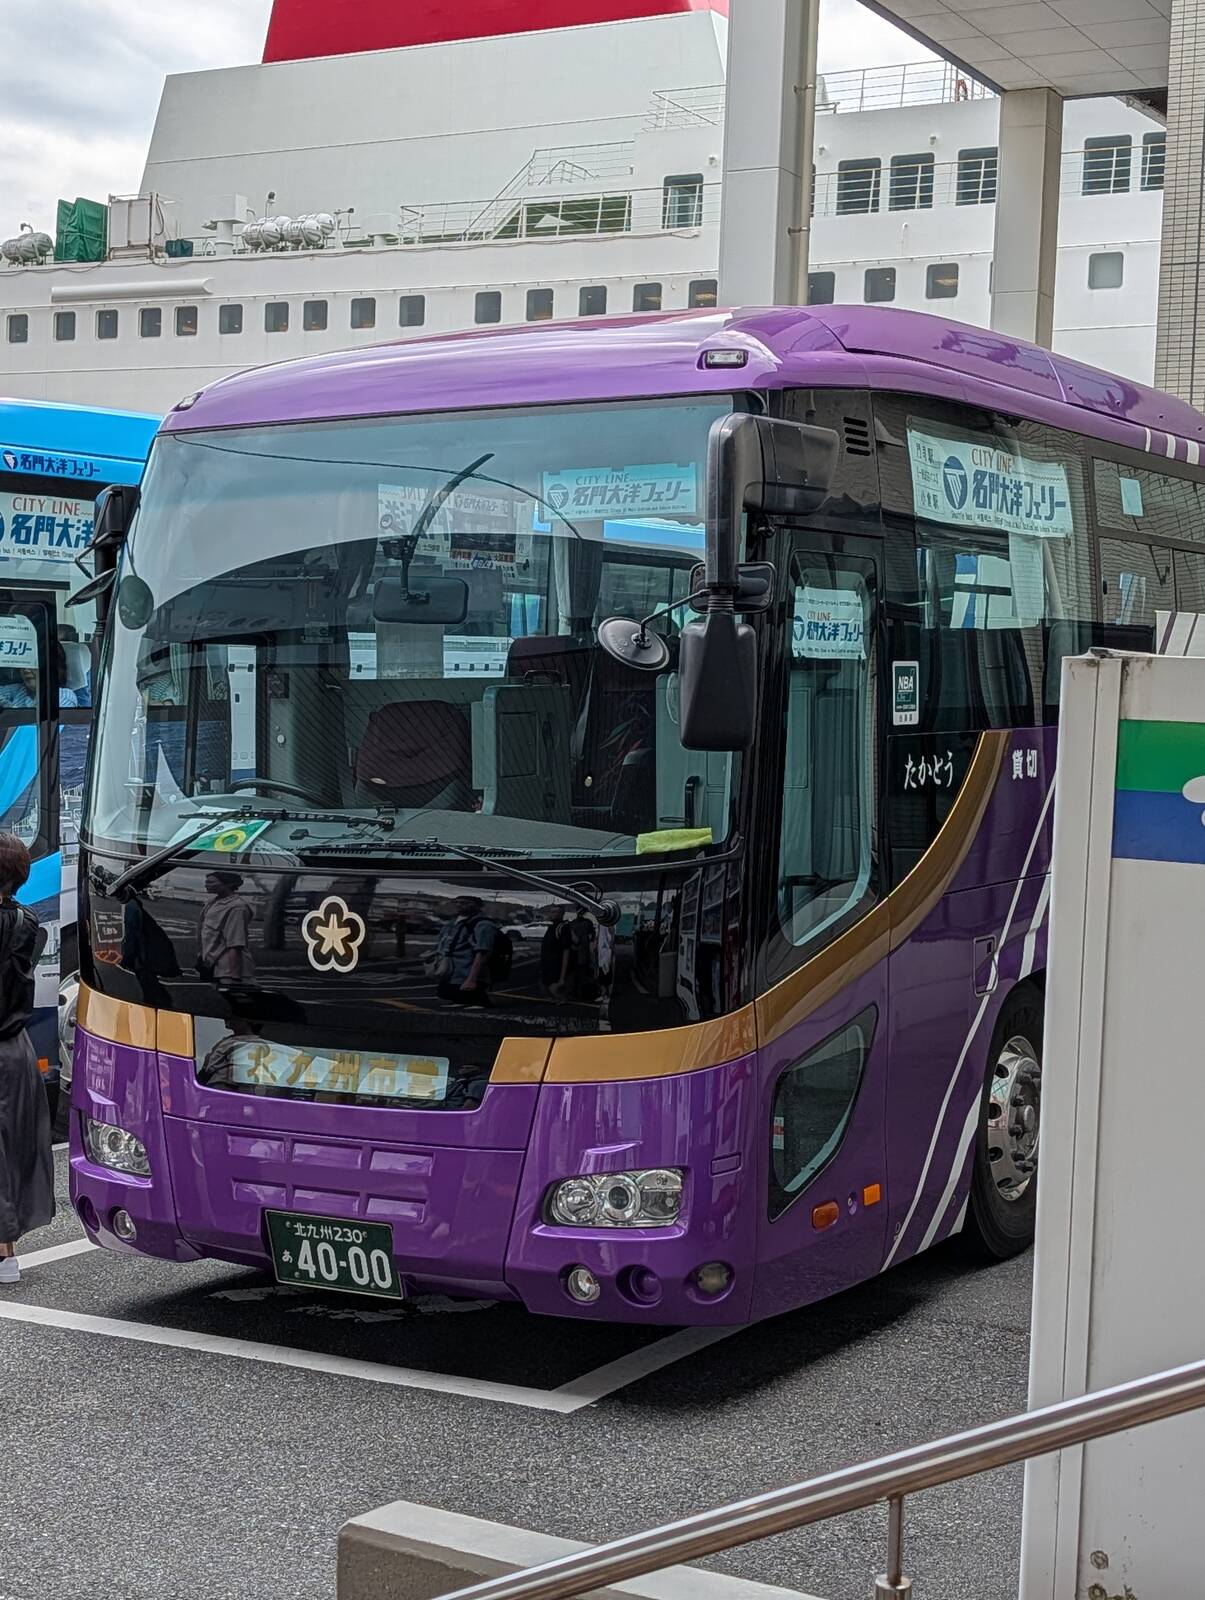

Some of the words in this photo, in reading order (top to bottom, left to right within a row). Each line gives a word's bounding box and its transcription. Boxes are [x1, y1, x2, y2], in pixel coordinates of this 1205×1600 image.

[20, 453, 101, 478] 名門大洋フェリー
[971, 448, 994, 469] CITY
[575, 474, 600, 486] CITY
[605, 472, 630, 483] LINE
[12, 497, 46, 513] CITY
[52, 500, 81, 517] LINE
[572, 480, 691, 507] 名門大洋フェリー
[972, 468, 1067, 522] 名門大洋フェリー
[10, 513, 94, 549] 名門大洋
[897, 675, 914, 690] NBA
[903, 749, 953, 791] たかとう
[1011, 748, 1038, 780] 貸切
[281, 1249, 293, 1263] あ
[297, 1239, 393, 1289] 40-00
